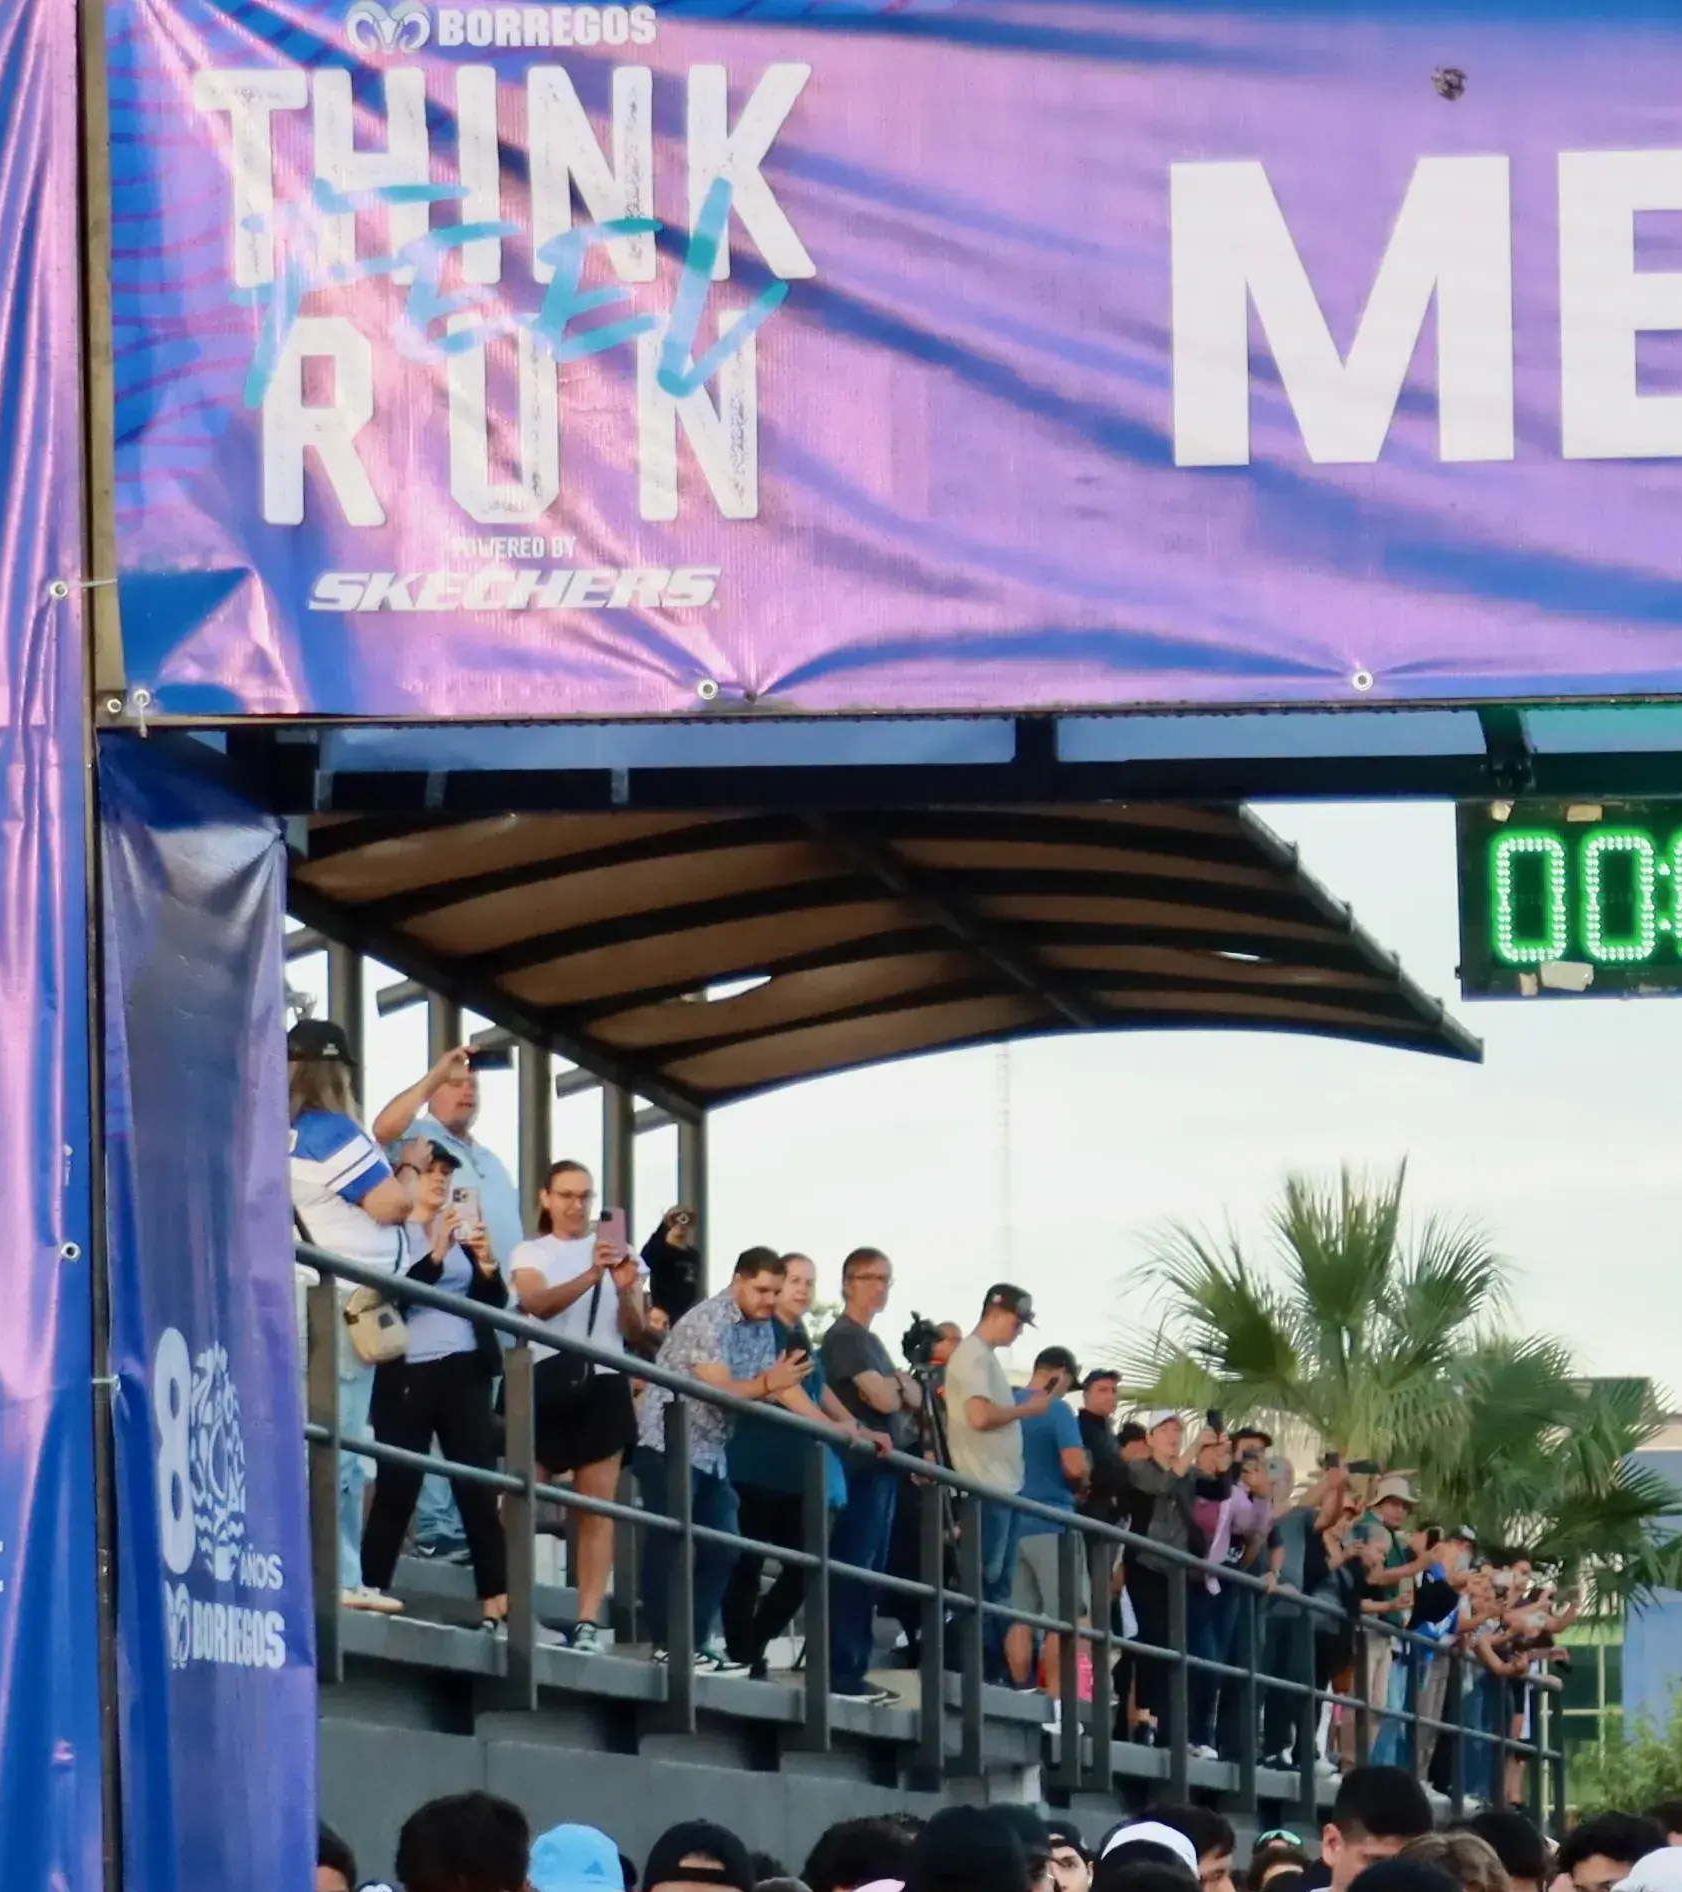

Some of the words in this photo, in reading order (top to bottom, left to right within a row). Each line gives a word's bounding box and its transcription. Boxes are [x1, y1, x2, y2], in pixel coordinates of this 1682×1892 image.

[437, 5, 658, 49] BORREGOS
[194, 63, 817, 288] THINK
[261, 309, 761, 527] RUN
[450, 537, 545, 560] POWERED
[550, 537, 577, 559] BY
[308, 568, 722, 612] SKECHERS
[239, 1543, 284, 1590] AÑOS
